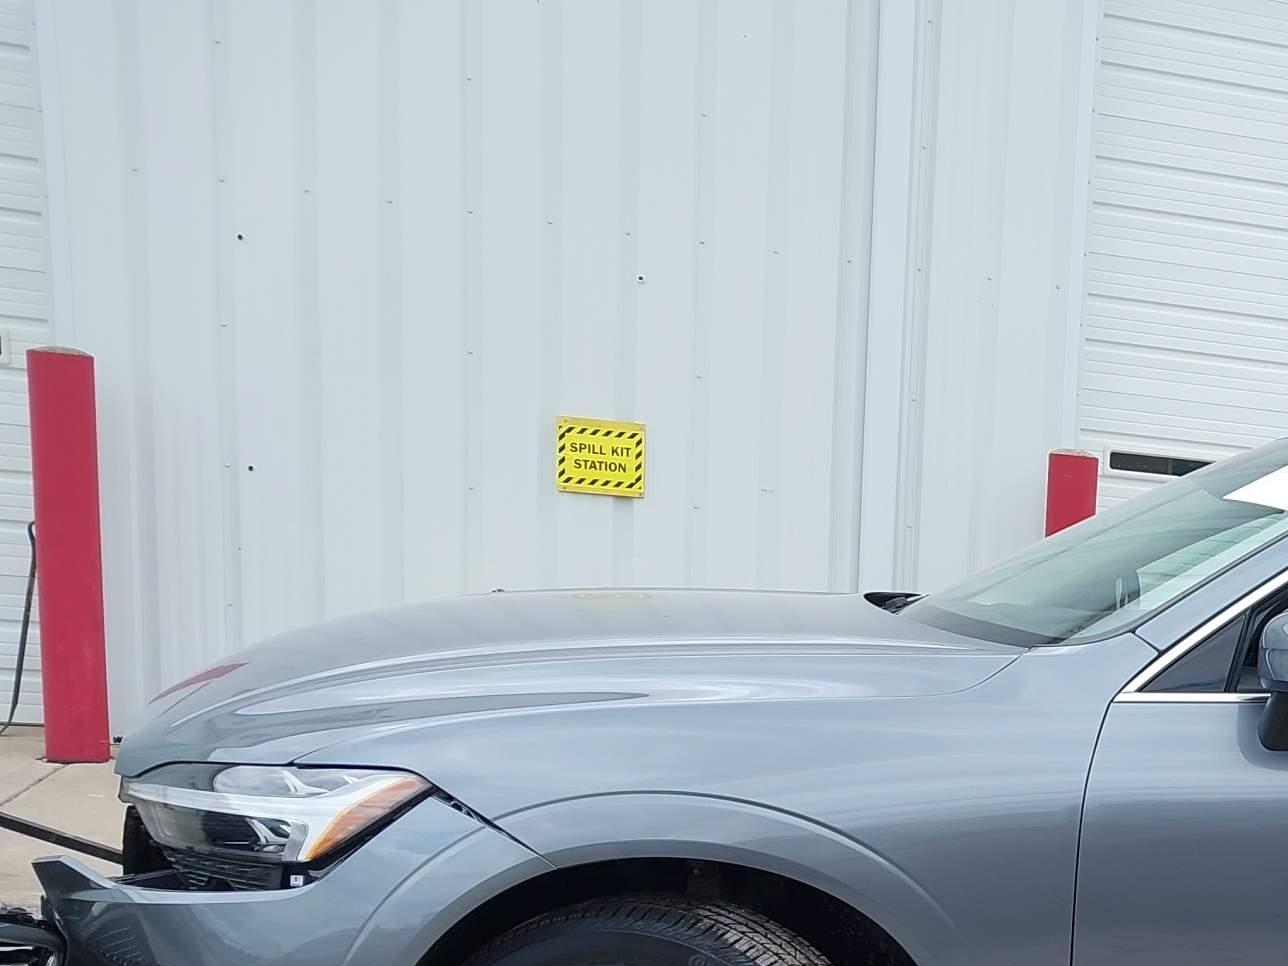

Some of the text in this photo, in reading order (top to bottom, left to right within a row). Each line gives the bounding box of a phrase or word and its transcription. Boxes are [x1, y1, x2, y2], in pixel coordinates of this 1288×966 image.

[569, 442, 632, 457] SPILL KIT
[573, 459, 627, 473] STATION
